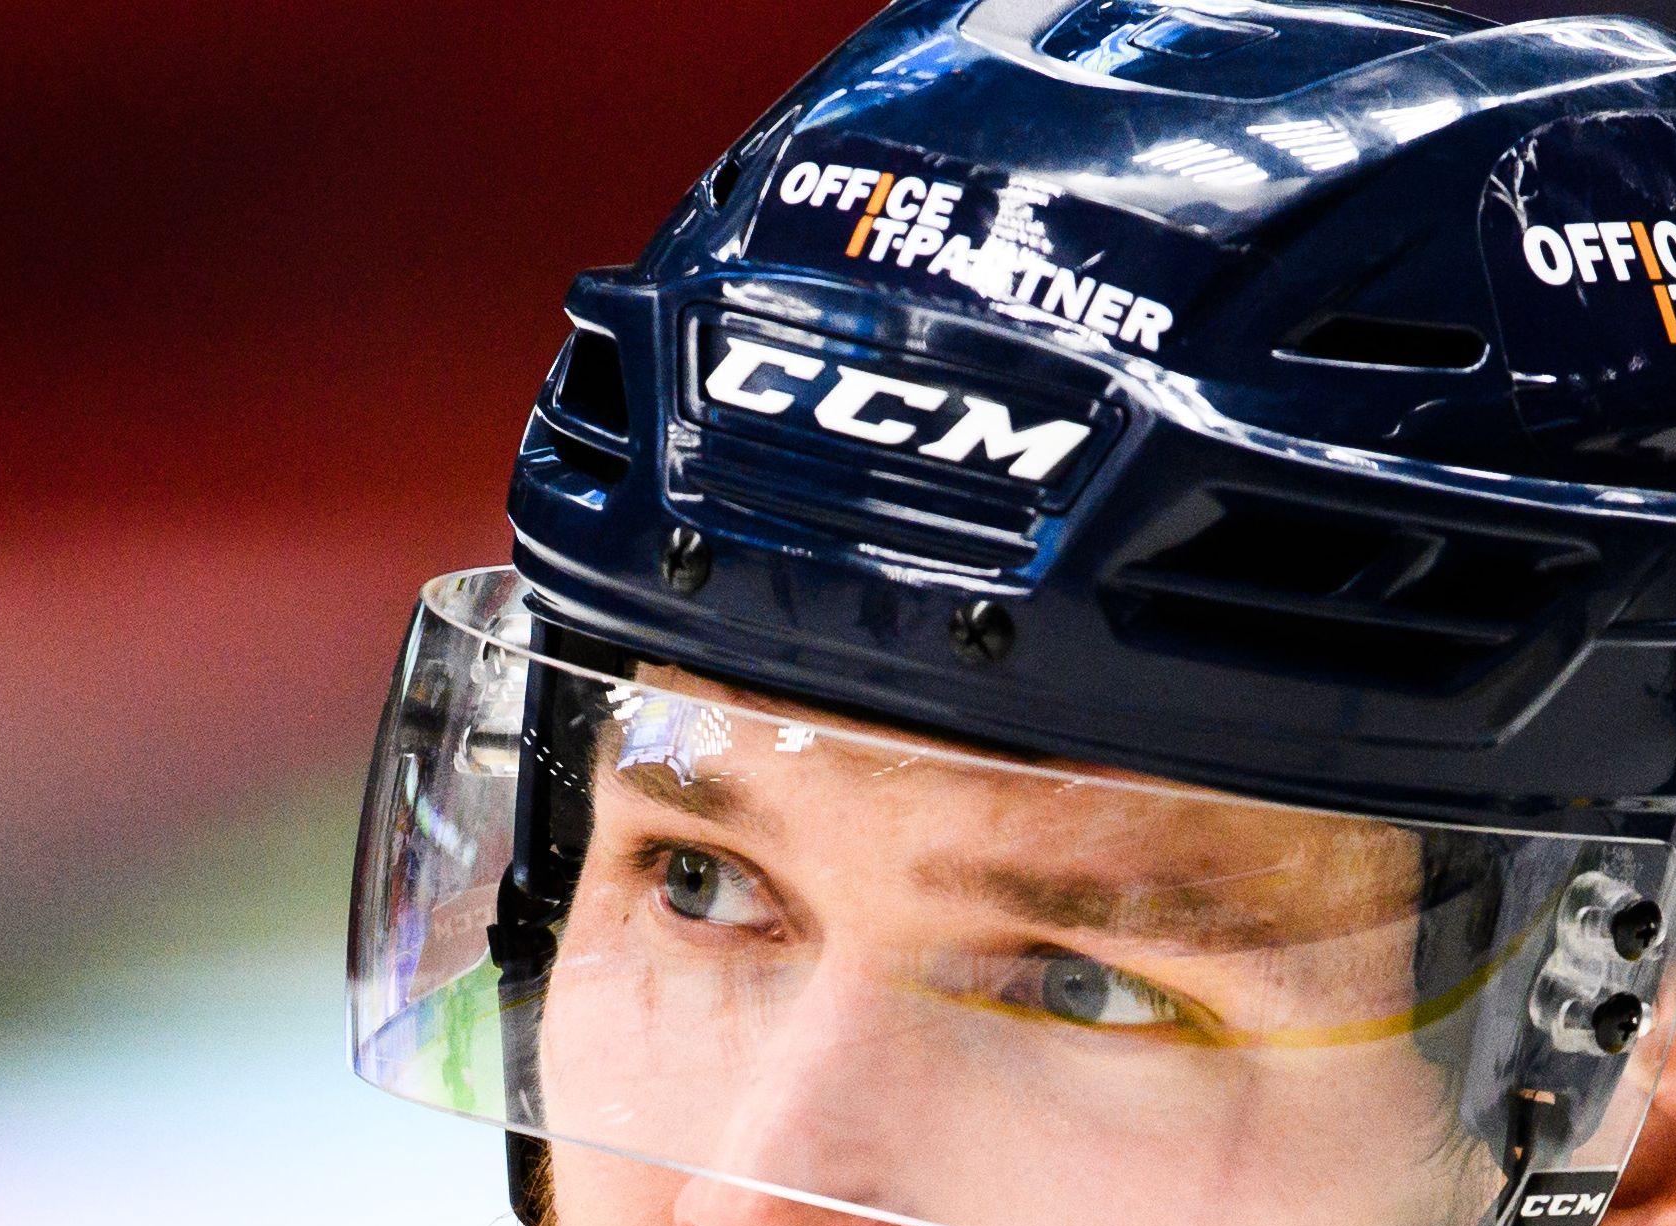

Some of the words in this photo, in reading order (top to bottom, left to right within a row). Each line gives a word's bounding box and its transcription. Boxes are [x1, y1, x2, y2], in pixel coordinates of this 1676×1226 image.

[780, 161, 963, 231] OFFICE
[705, 336, 1091, 481] CCM
[1520, 1192, 1607, 1217] CCM
